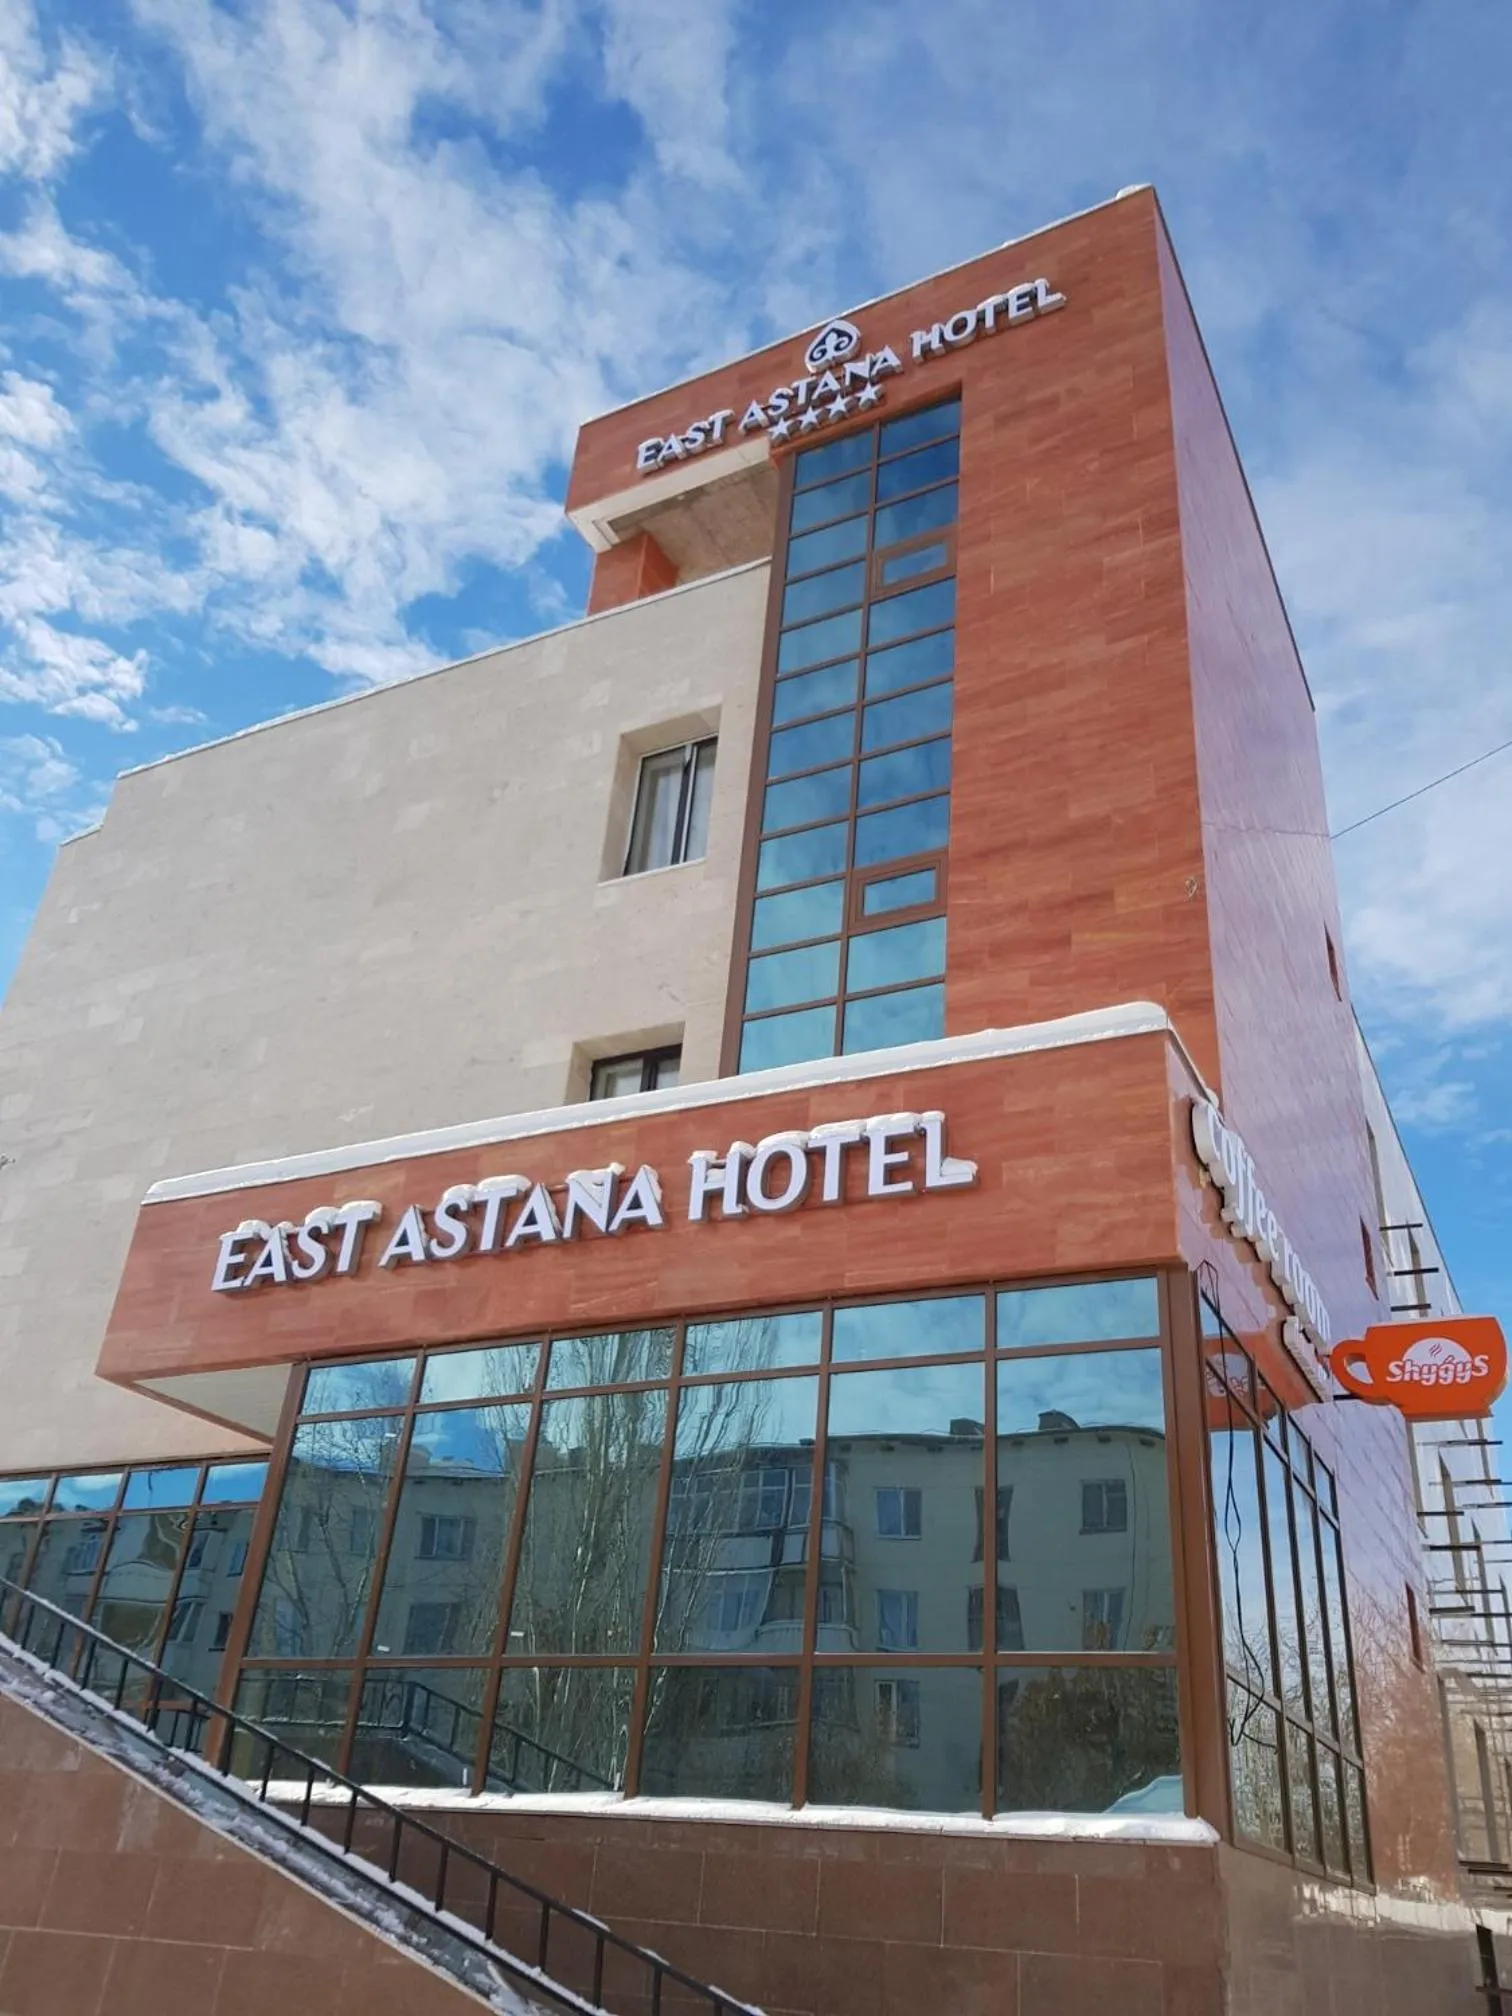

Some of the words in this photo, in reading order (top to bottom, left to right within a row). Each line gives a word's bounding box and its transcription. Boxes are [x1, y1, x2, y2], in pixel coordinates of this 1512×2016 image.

[635, 408, 733, 474] EAST
[739, 344, 903, 433] ASTANA
[911, 277, 1067, 362] HOTEL
[211, 1202, 382, 1292] EAST
[378, 1164, 664, 1268] ASTANA
[687, 1111, 979, 1222] HOTEL
[1282, 1237, 1332, 1344] room
